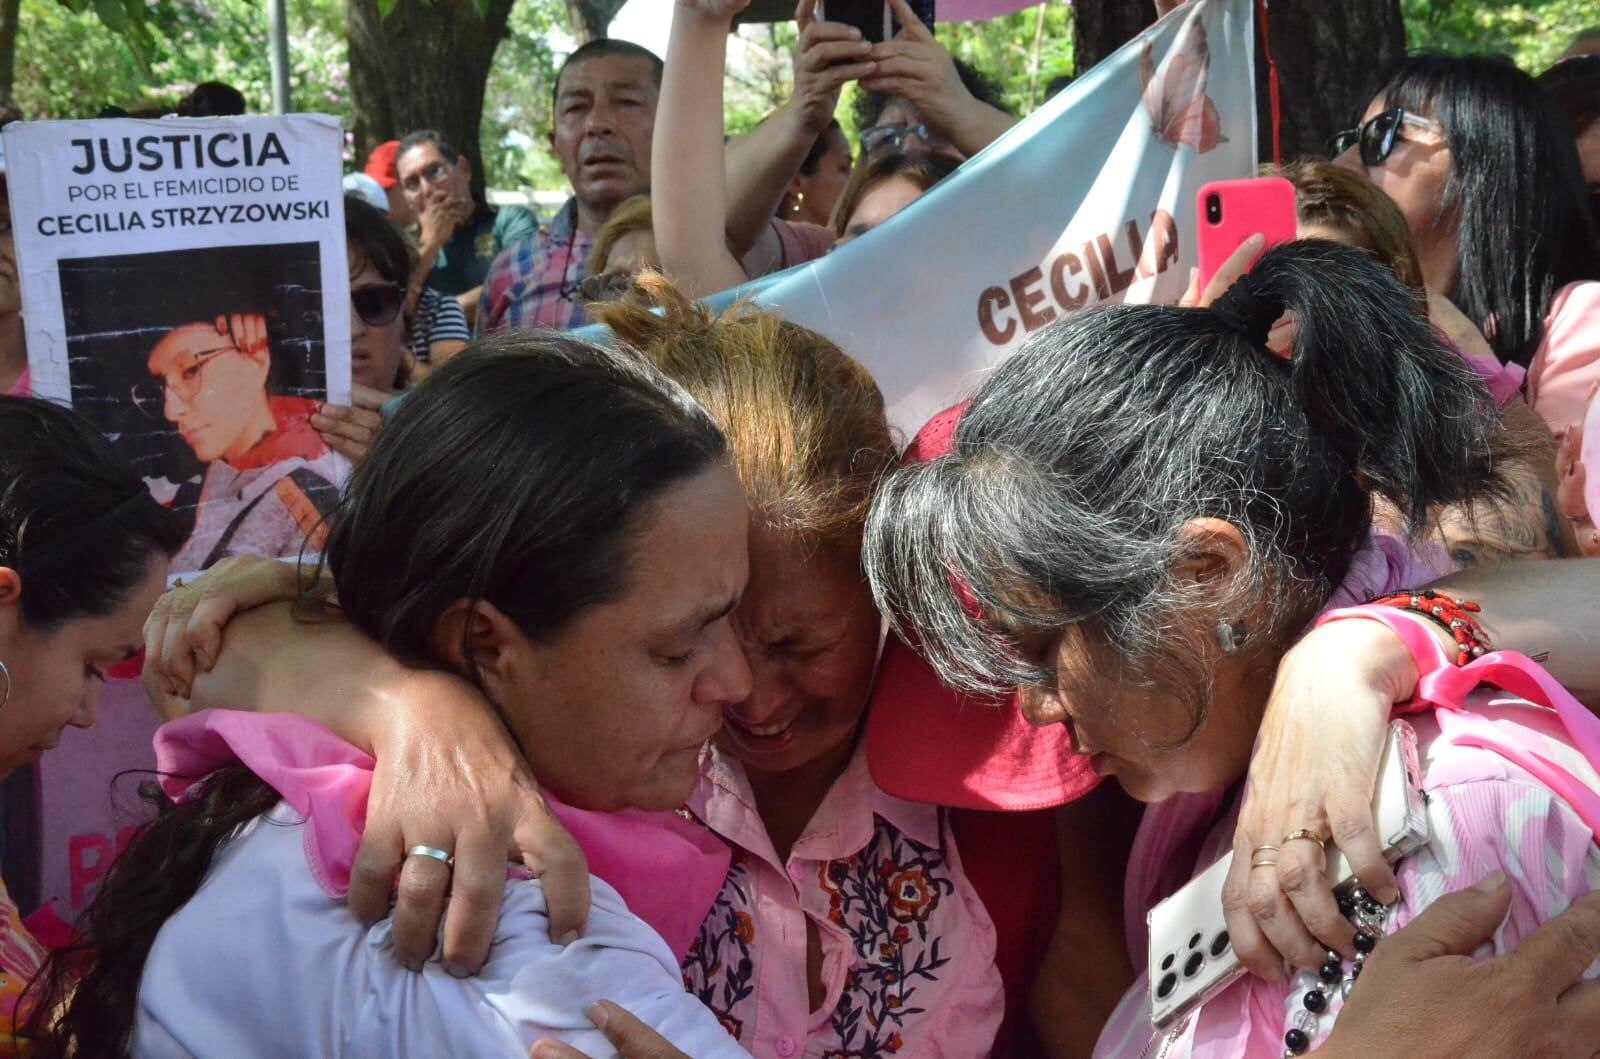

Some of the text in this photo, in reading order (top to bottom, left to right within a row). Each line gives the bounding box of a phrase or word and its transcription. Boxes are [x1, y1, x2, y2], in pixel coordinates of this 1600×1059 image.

[71, 132, 290, 174] JUSTICIA
[68, 175, 299, 202] POR EL FEMICIDIO DE
[37, 200, 330, 236] CECILIA STRZYZOWSKI
